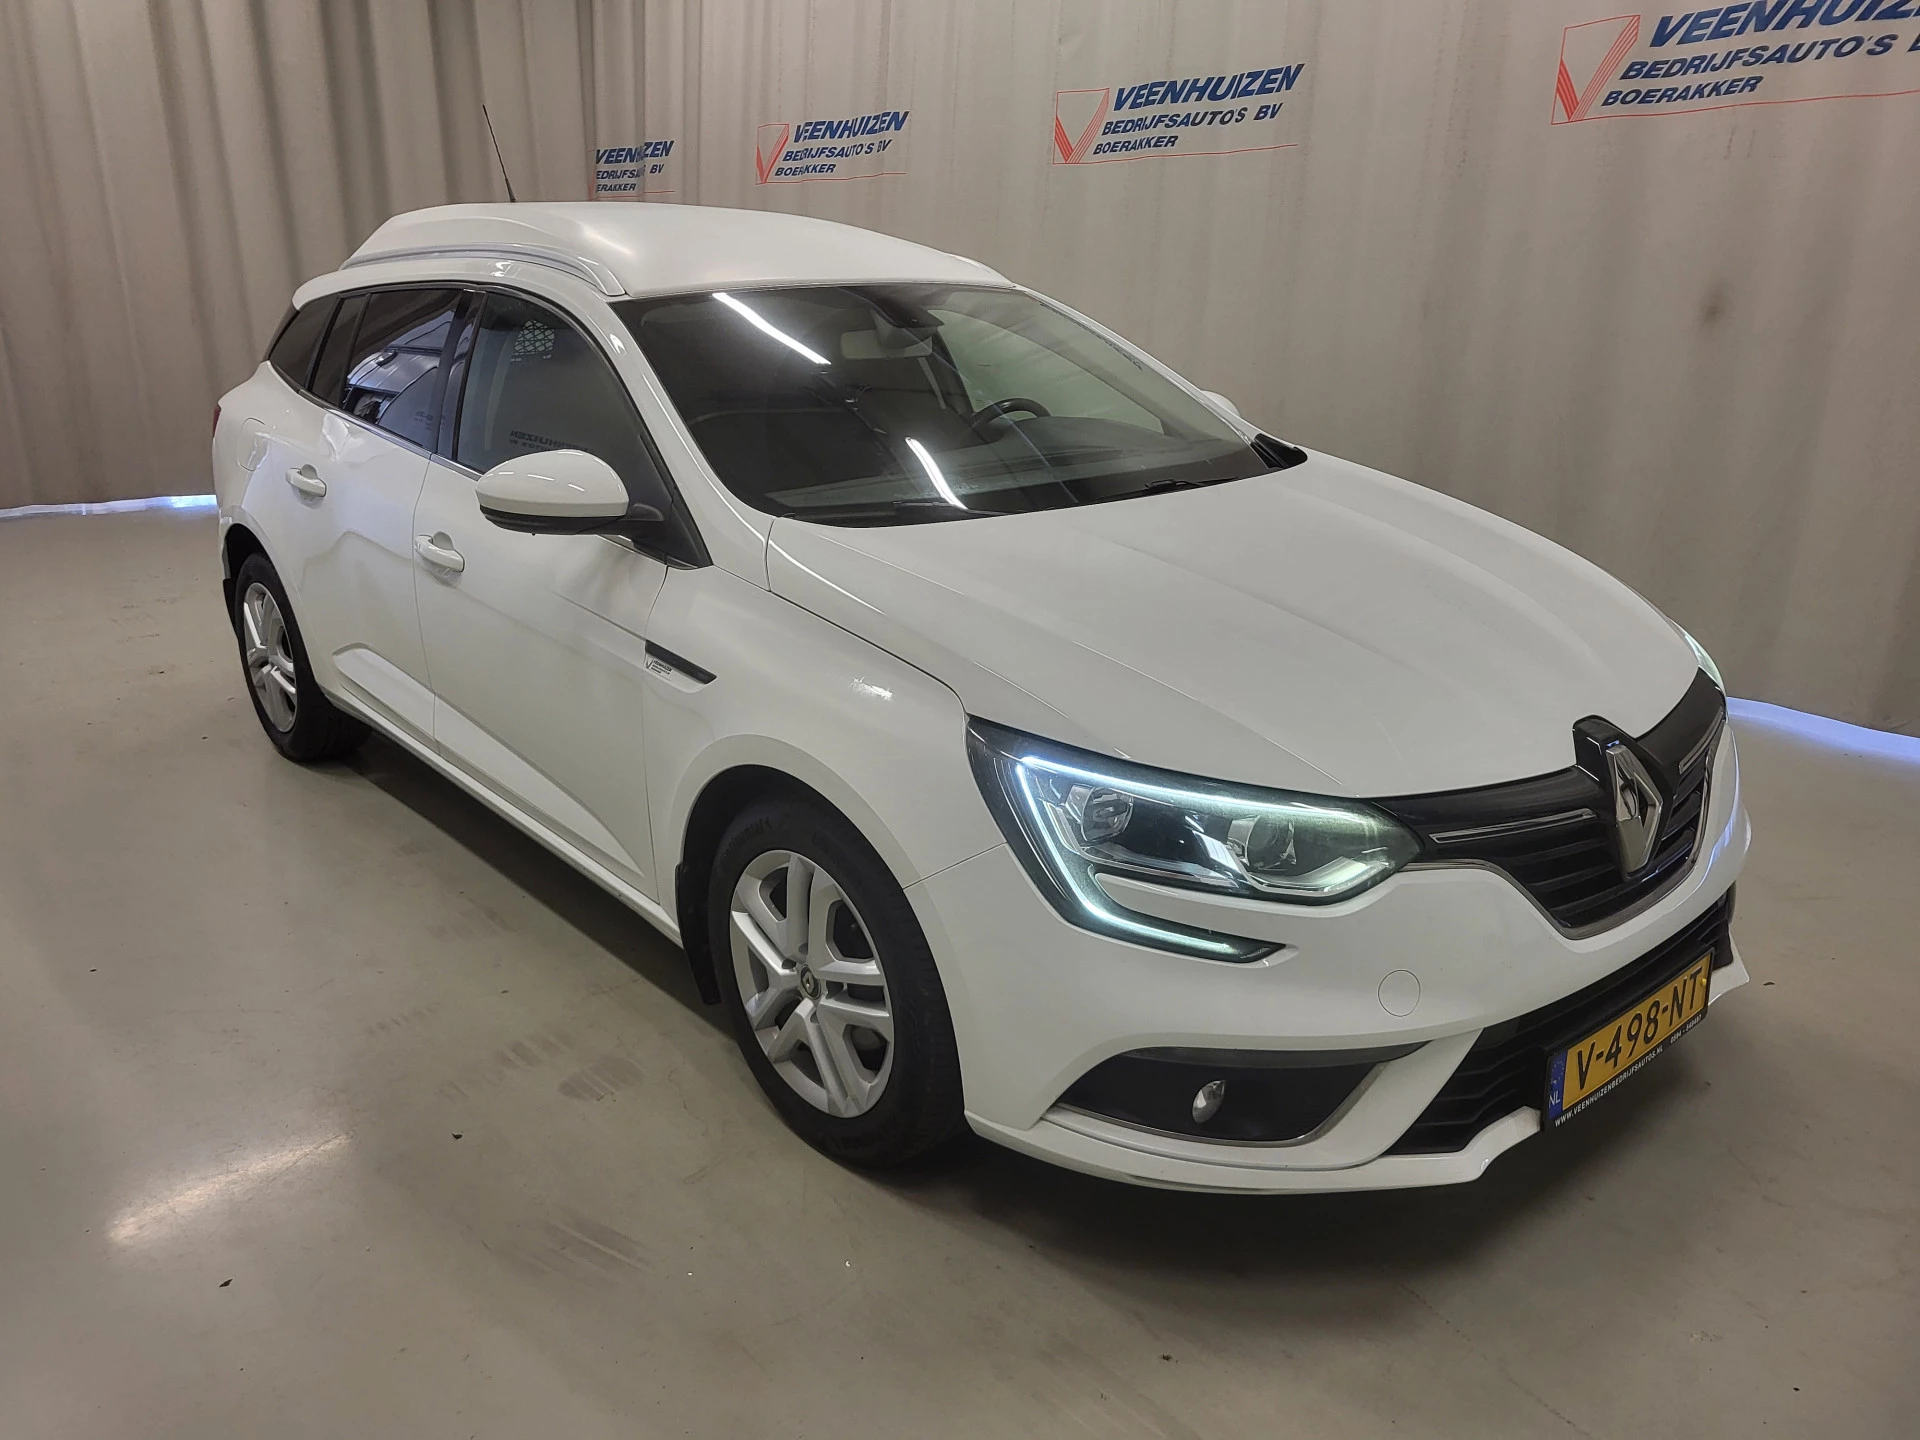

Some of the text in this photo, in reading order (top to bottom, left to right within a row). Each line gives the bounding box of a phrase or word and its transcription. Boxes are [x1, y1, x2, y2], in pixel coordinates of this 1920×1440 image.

[1649, 0, 1920, 48] VEENHUIZ
[1619, 33, 1899, 80] BEDRIJFSAUTO'S
[1113, 63, 1306, 112] VEENHUIZEN
[1601, 75, 1764, 107] BOERAKKER
[793, 111, 909, 143] VEENHUIZEN
[1101, 102, 1284, 136] BEDRIJFSAUTO'S BV
[595, 140, 674, 165] VEENHZEN
[782, 139, 893, 162] BEDRIJFSAUTO'S BV
[1093, 135, 1179, 155] BOERAKKER
[649, 163, 665, 174] BV
[1577, 967, 1703, 1091] V-498-NT
[1549, 1090, 1561, 1109] NL
[1554, 1045, 1664, 1127] WWW.VEENHUIZENBEDRIJFSAUTOS.NL
